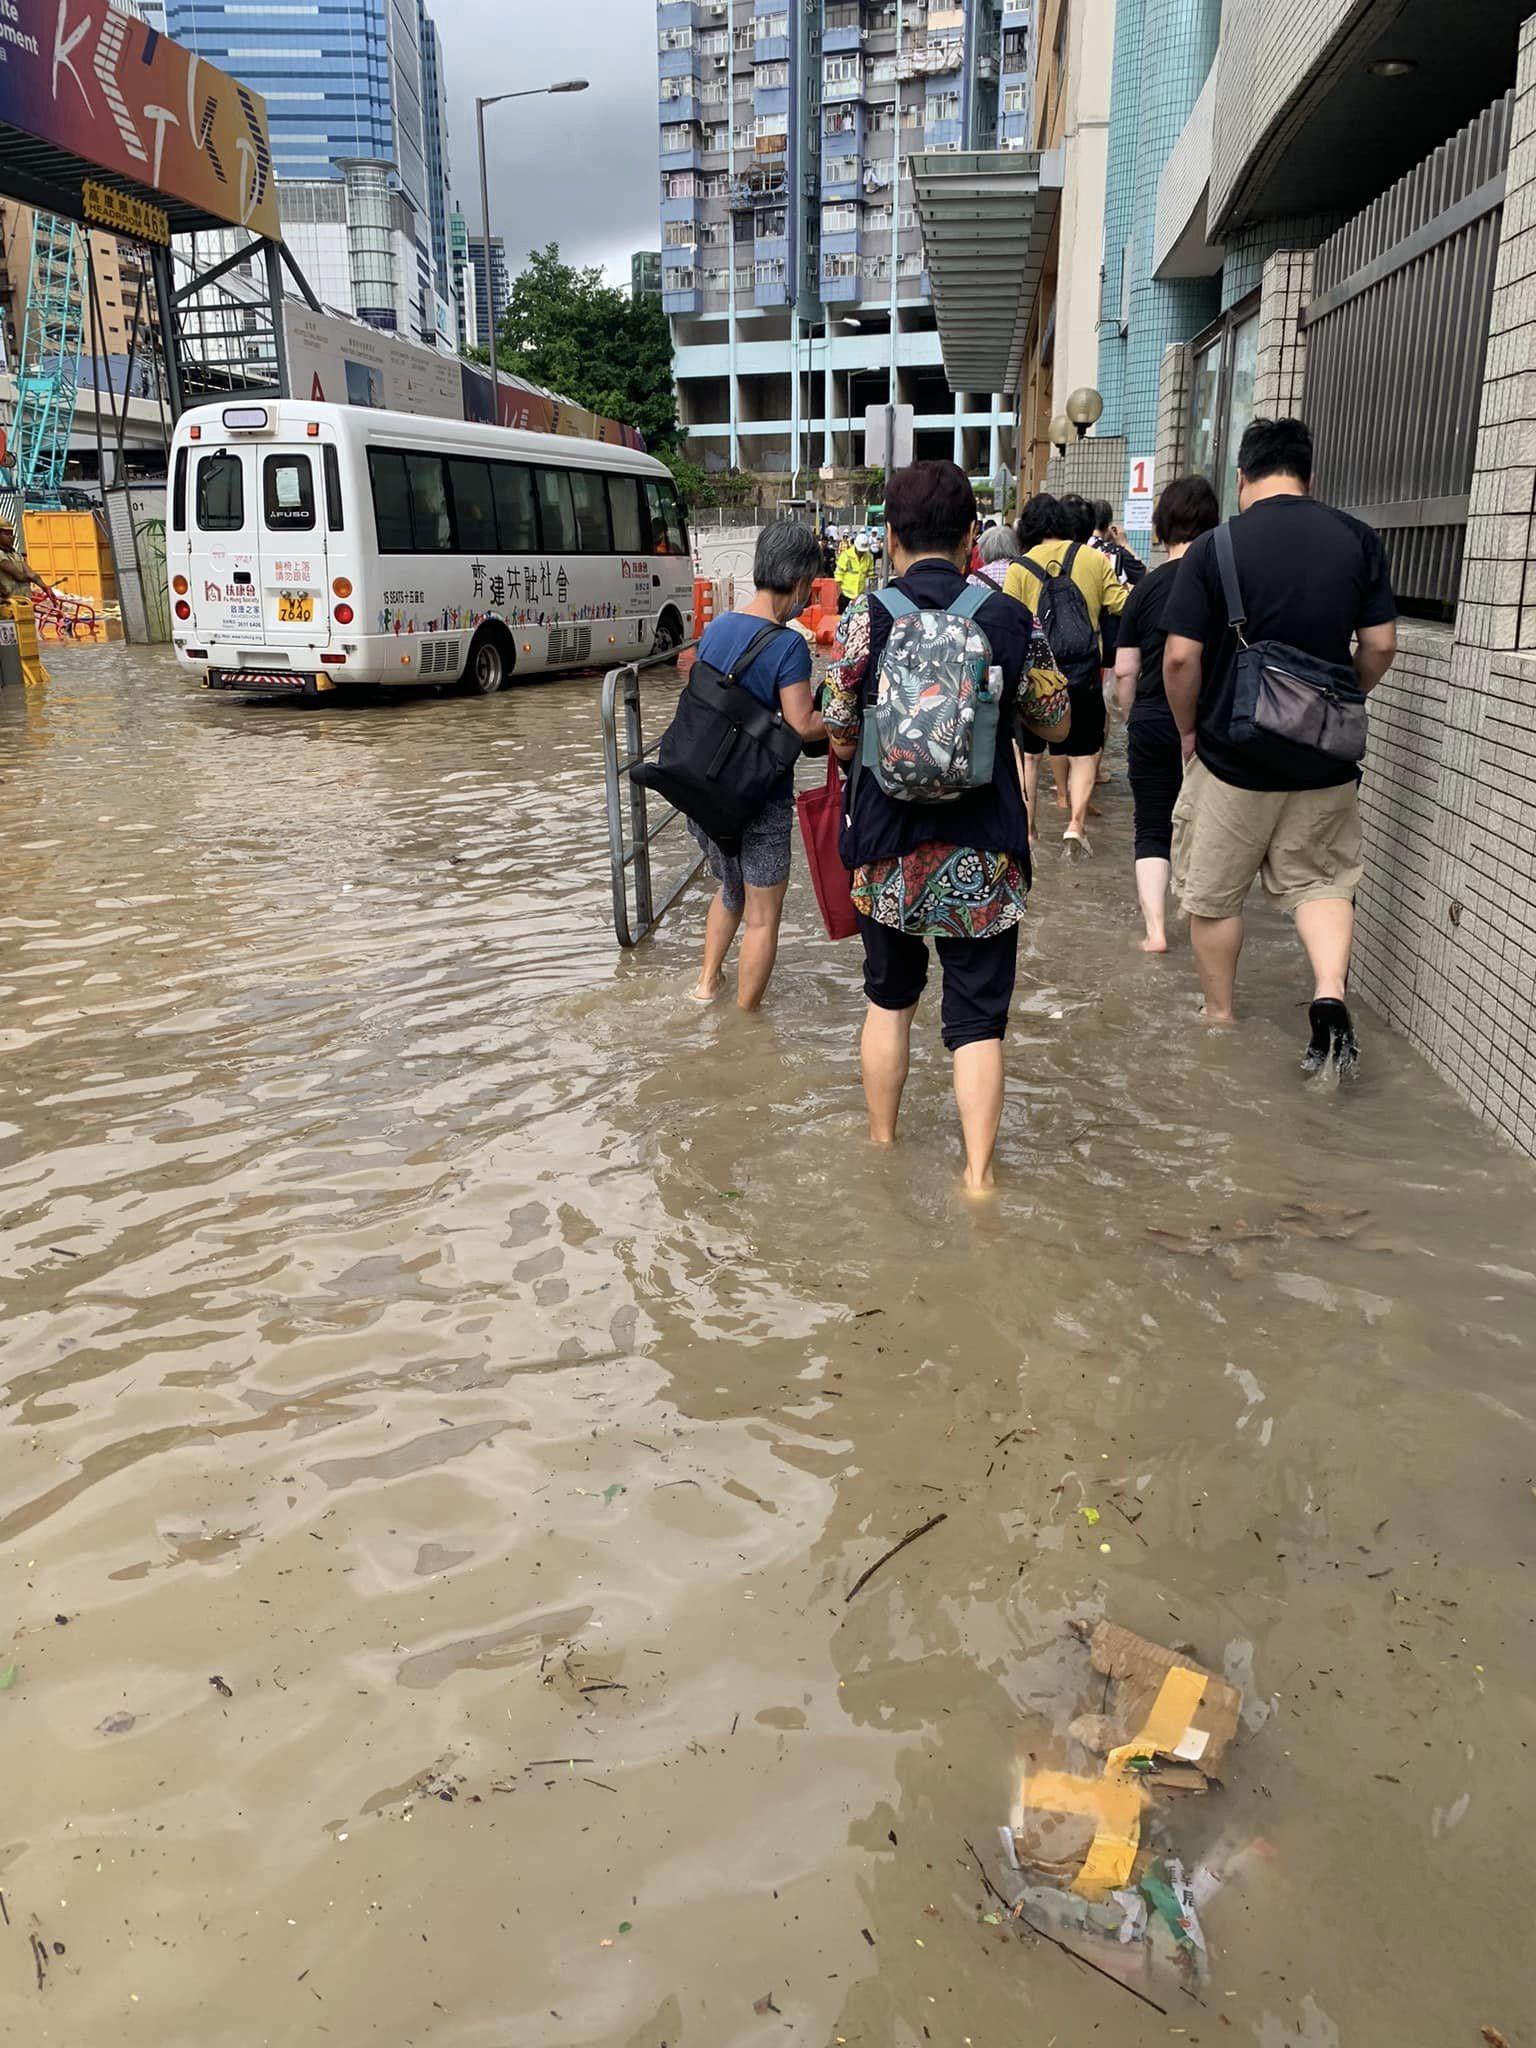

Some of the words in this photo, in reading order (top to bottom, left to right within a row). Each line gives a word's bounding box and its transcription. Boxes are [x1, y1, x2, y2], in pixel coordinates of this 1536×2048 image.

[89, 202, 141, 227] HEADROOM
[1132, 461, 1148, 492] 1
[471, 557, 570, 606] 齊建共融社會
[288, 599, 303, 609] WX
